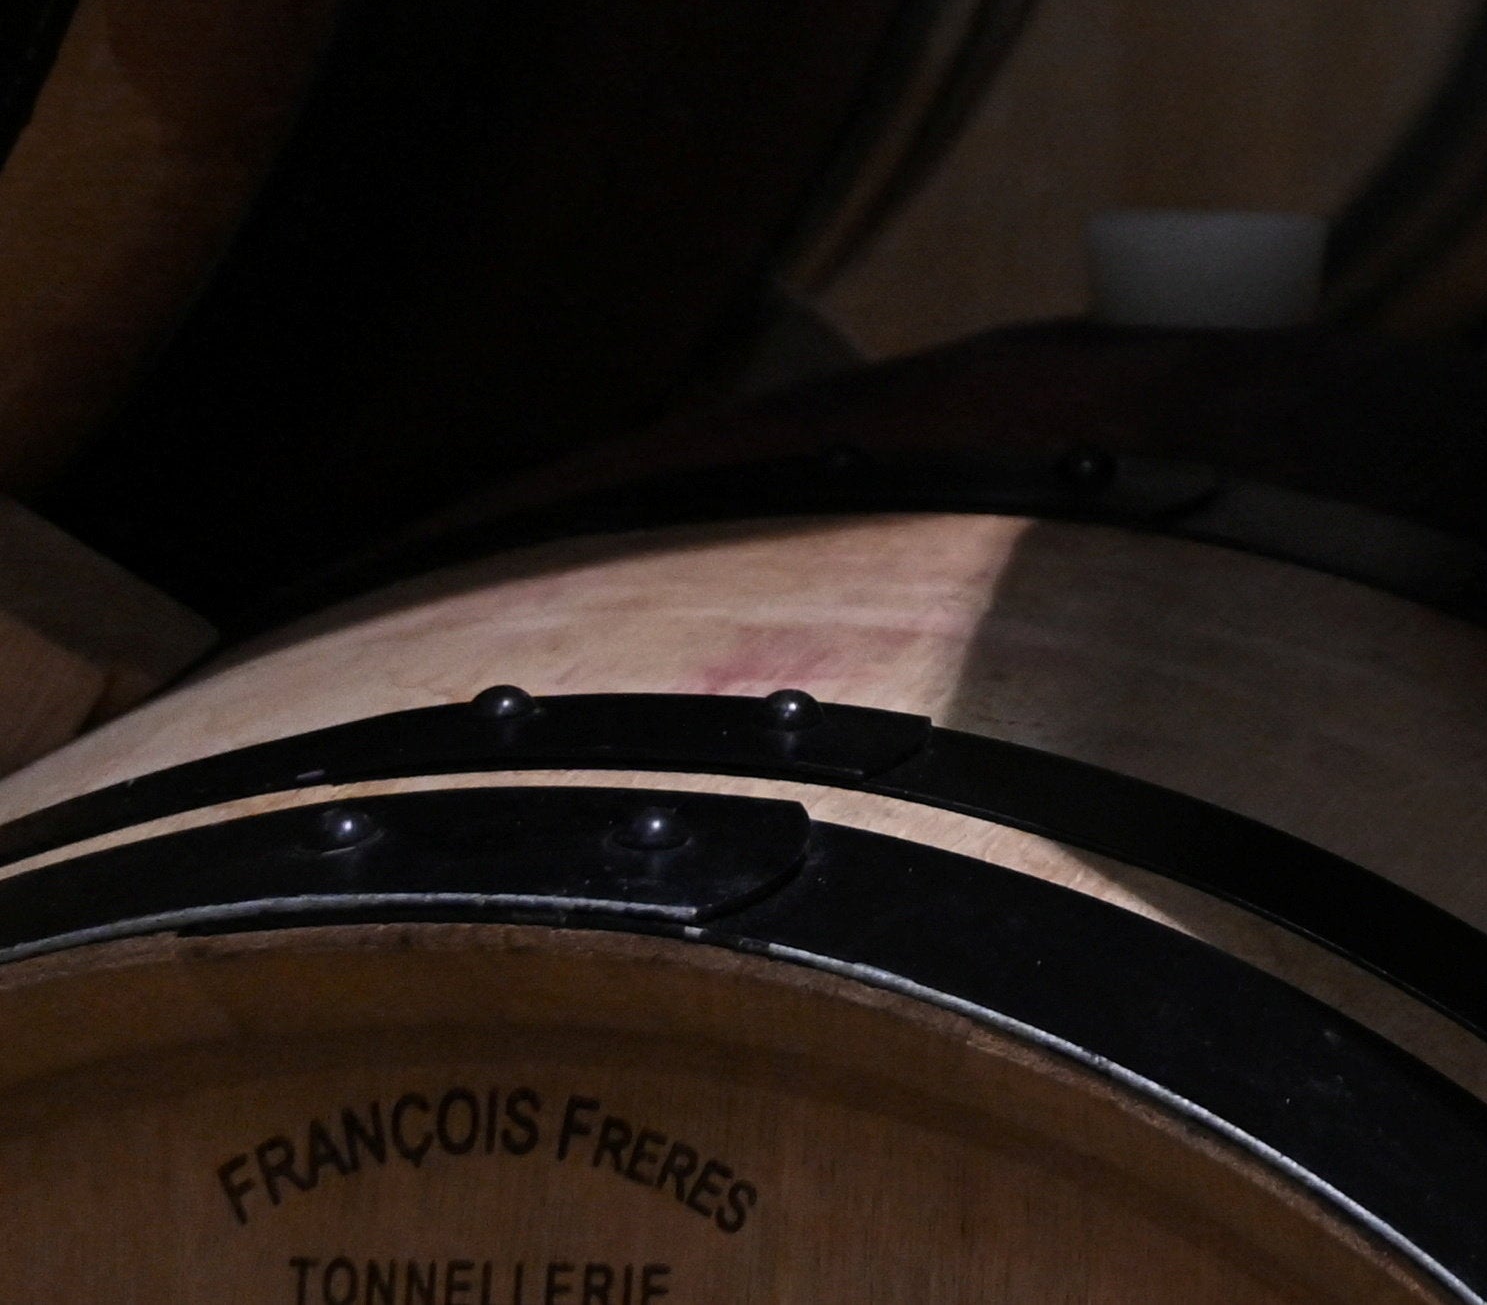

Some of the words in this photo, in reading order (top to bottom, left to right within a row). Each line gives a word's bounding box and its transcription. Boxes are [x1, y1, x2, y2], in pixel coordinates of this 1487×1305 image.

[216, 1086, 541, 1225] FRANÇOIS
[557, 1094, 758, 1234] FRERES
[288, 1256, 672, 1305] TONNELLERIE
